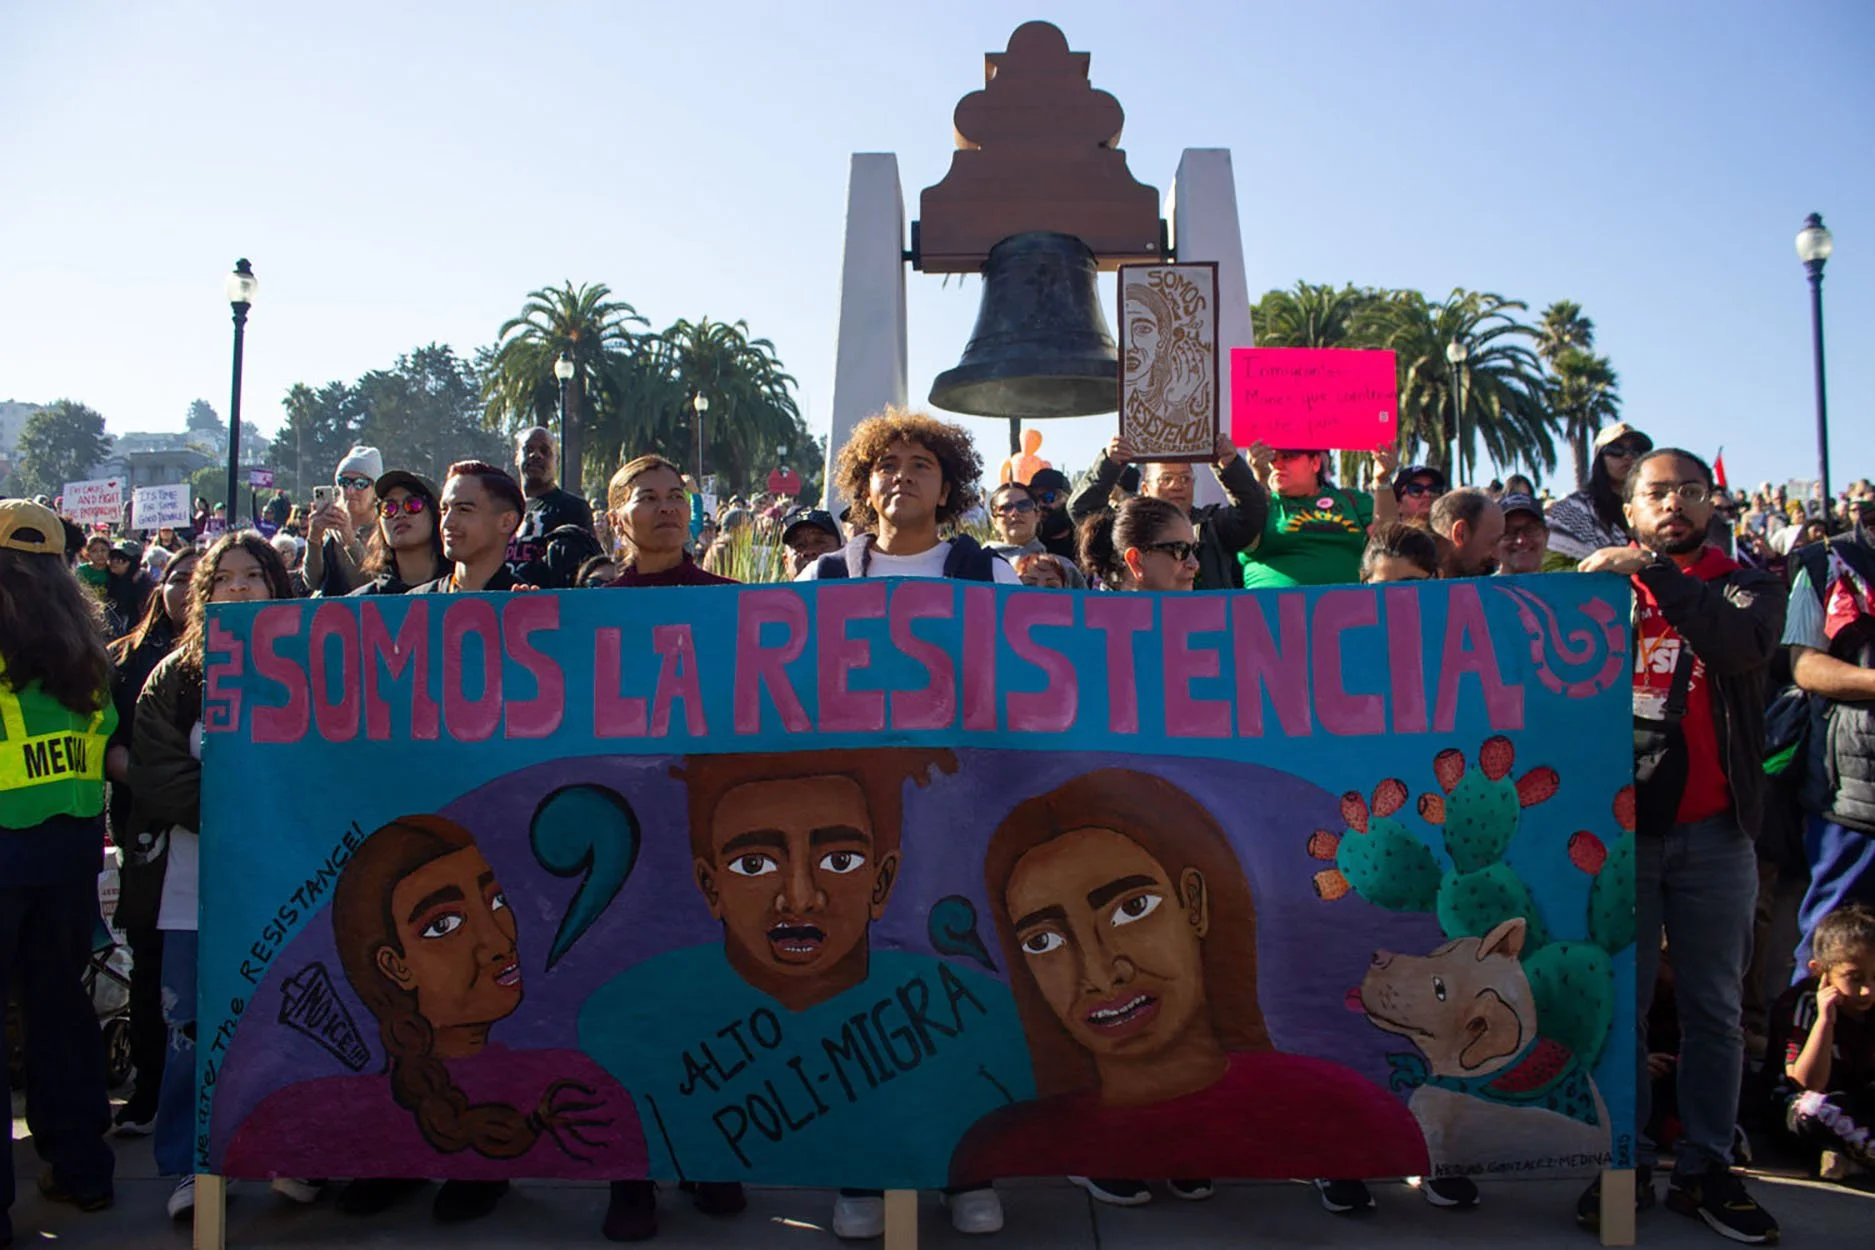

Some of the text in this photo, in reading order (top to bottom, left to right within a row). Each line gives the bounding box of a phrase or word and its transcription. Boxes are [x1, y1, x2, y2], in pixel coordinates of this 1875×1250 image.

[1147, 271, 1207, 317] SOMOS
[1126, 387, 1210, 444] RESISTENCIA
[78, 495, 97, 504] AND
[251, 581, 1525, 743] SOMOS LA RESISTENCIA
[240, 820, 366, 984] RESISTANCE!
[295, 981, 333, 1028] NO
[679, 1007, 782, 1095] ALTO
[712, 962, 987, 1168] POLI-MIGRA
